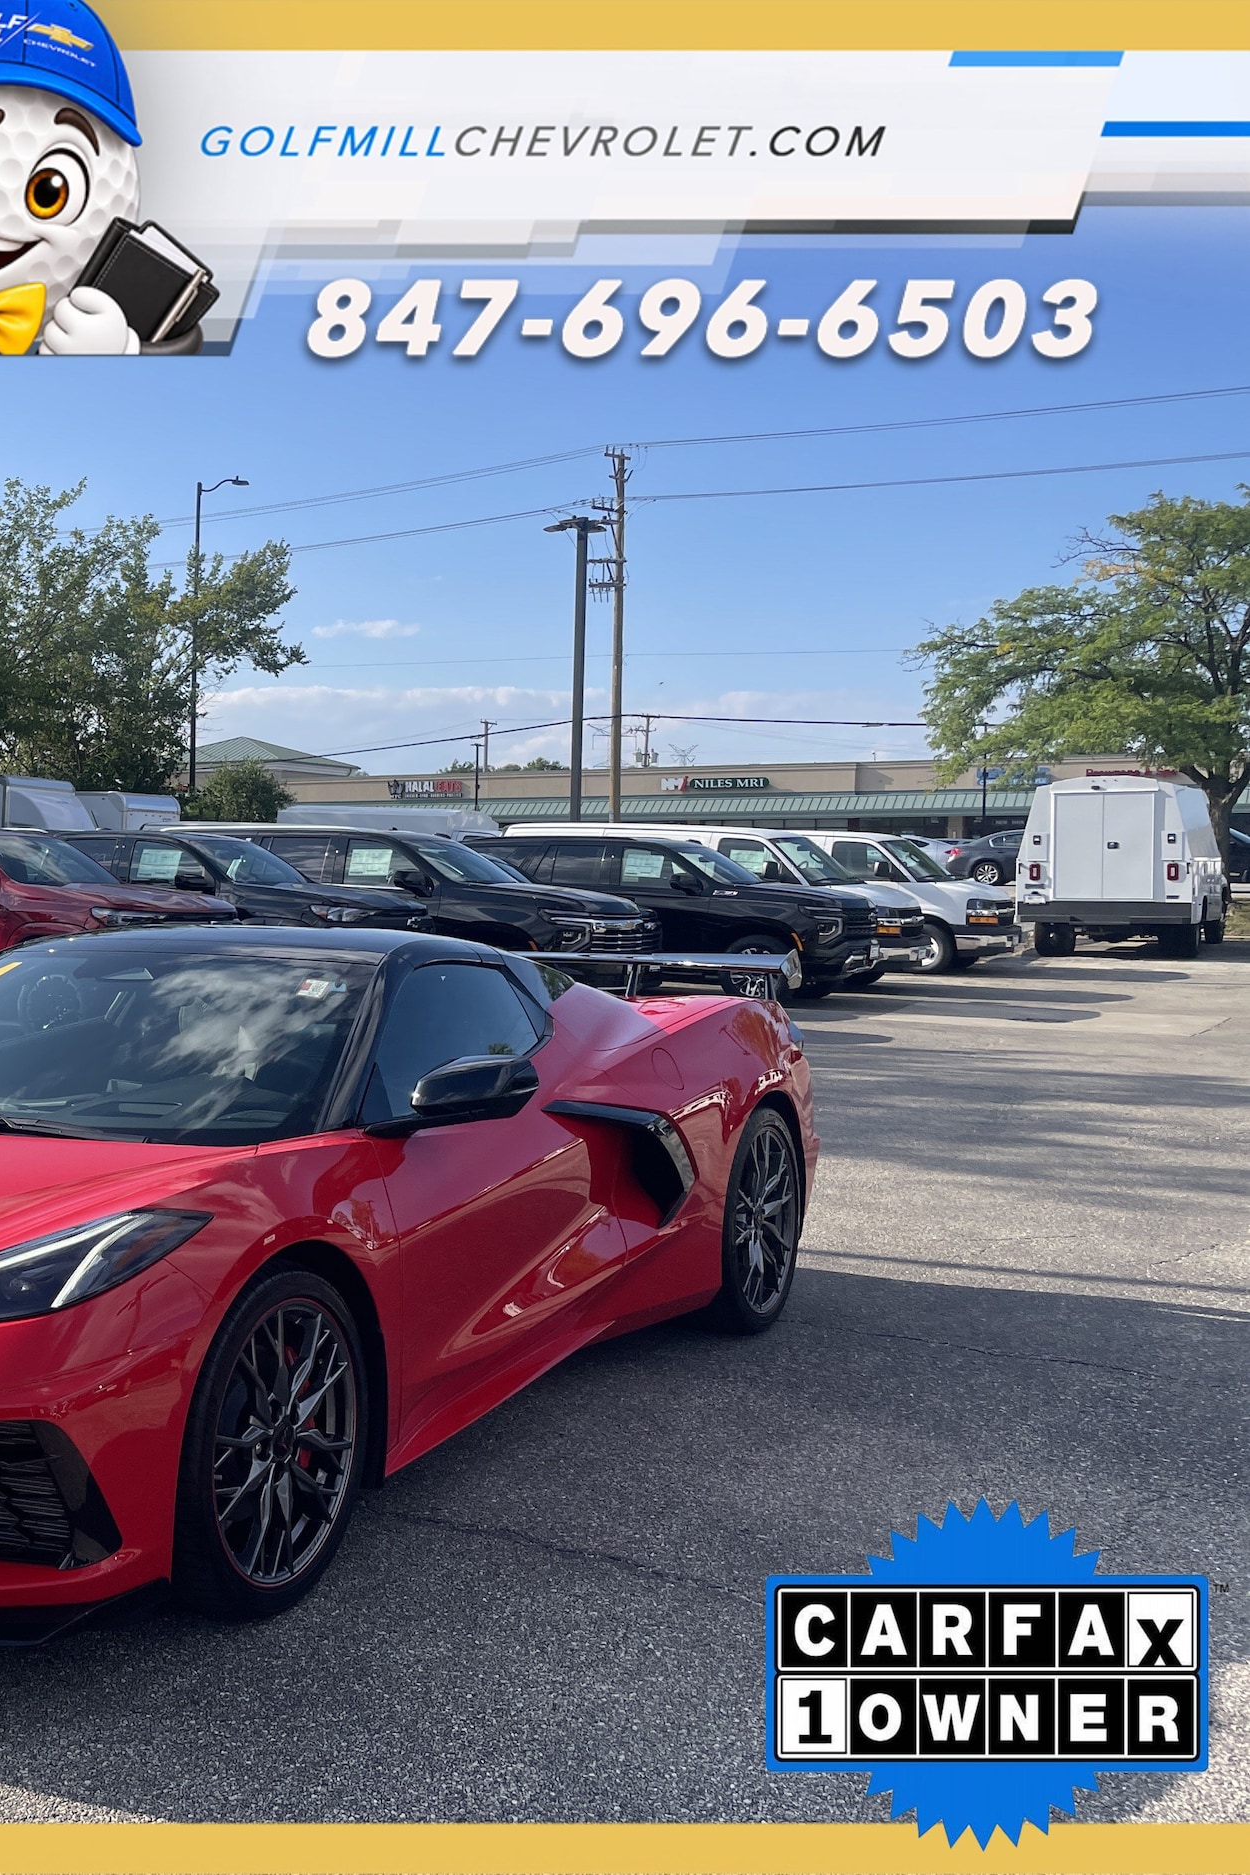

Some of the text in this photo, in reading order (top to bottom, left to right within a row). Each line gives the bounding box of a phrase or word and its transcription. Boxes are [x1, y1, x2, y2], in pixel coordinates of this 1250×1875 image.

[405, 780, 462, 793] HALAL EATS
[694, 778, 764, 789] NILES MRI
